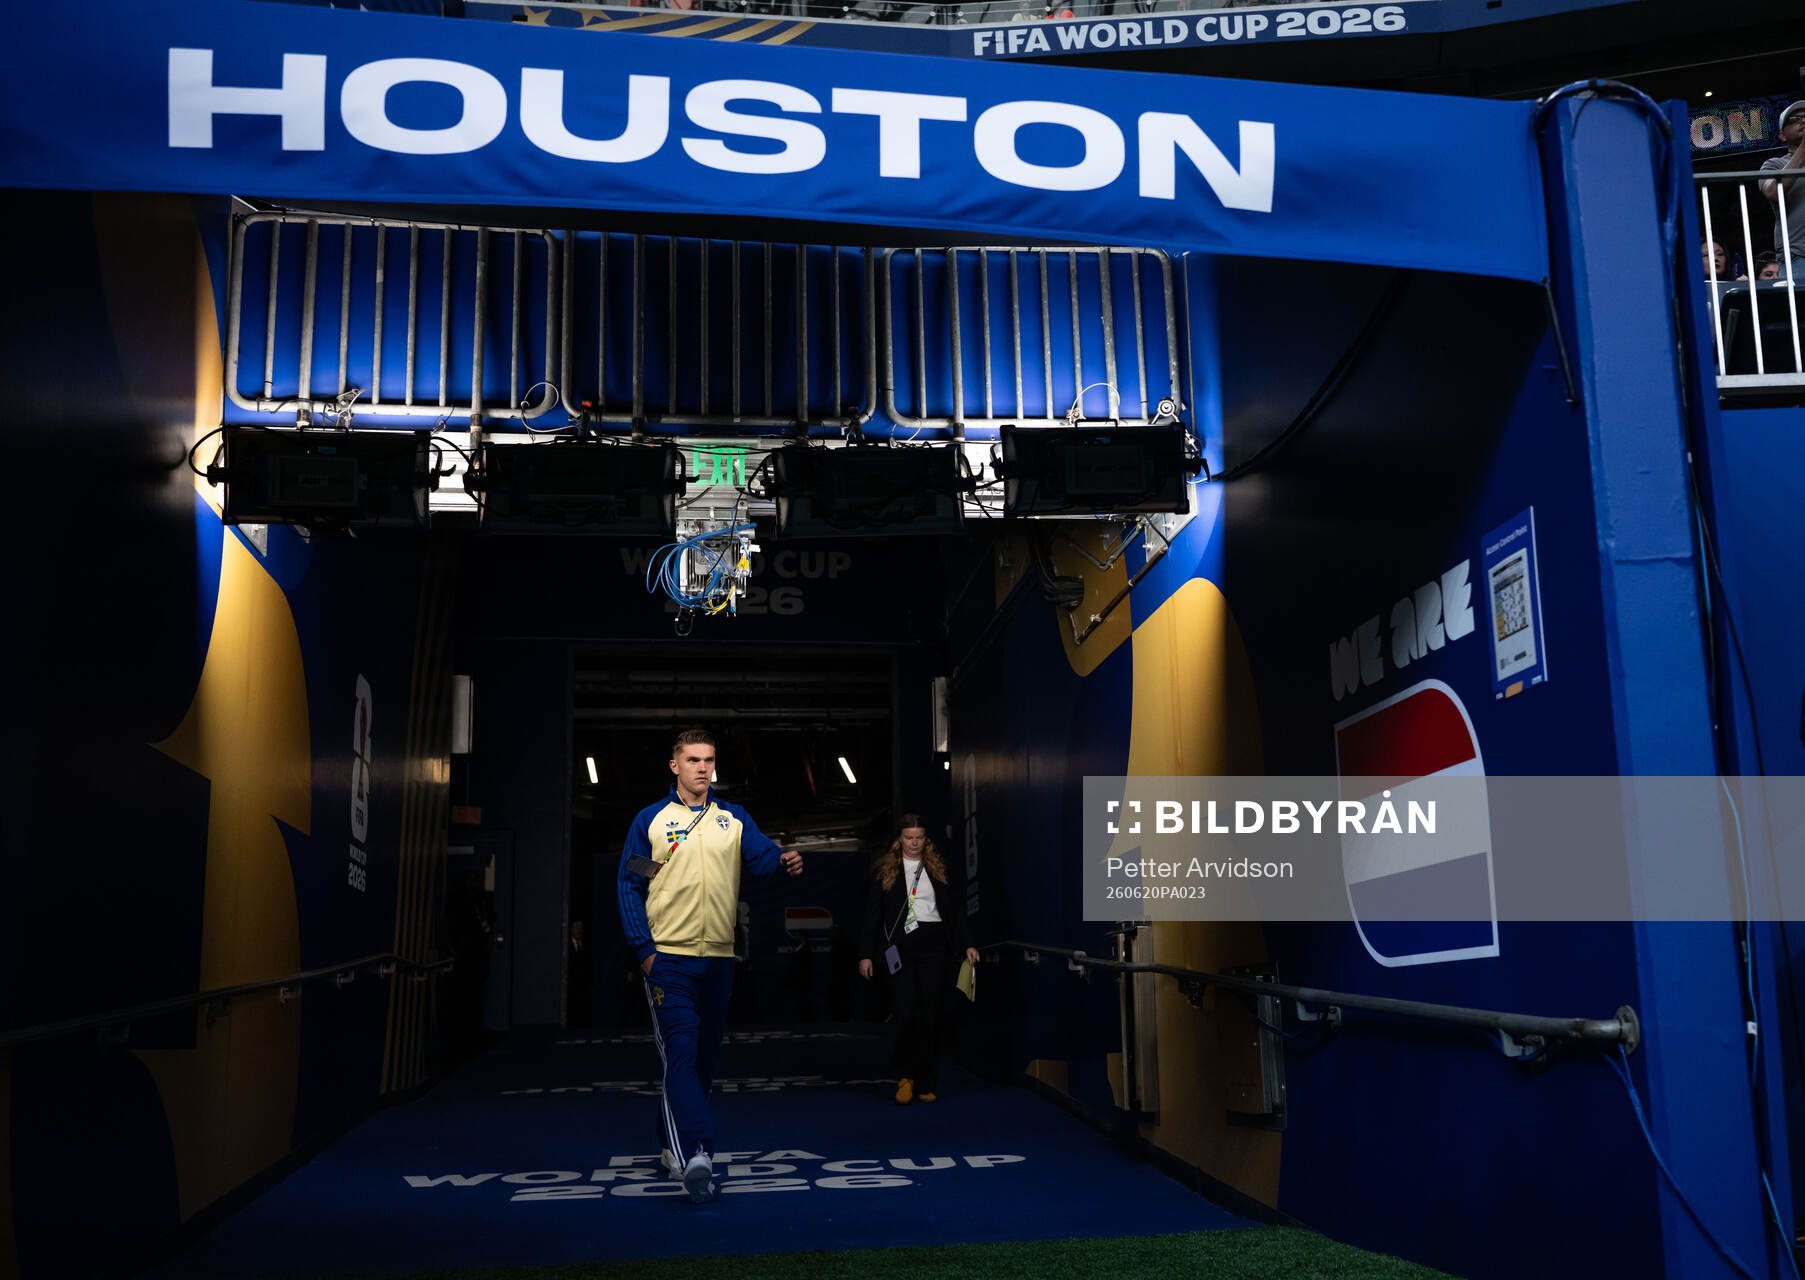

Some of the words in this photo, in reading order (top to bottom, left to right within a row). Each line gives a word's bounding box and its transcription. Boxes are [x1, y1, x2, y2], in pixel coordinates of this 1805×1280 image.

[973, 28, 1051, 56] FIFA
[1056, 19, 1189, 50] WORLD
[1195, 14, 1269, 42] CUP
[1275, 6, 1406, 37] 2026
[168, 47, 1276, 214] HOUSTON
[693, 445, 746, 486] EXIT
[774, 550, 852, 579] CUP
[1329, 613, 1384, 703] WE
[402, 1163, 798, 1188] WORD
[821, 1154, 1027, 1173] CUP
[608, 1150, 828, 1167] FFA
[509, 1174, 914, 1202] 2026
